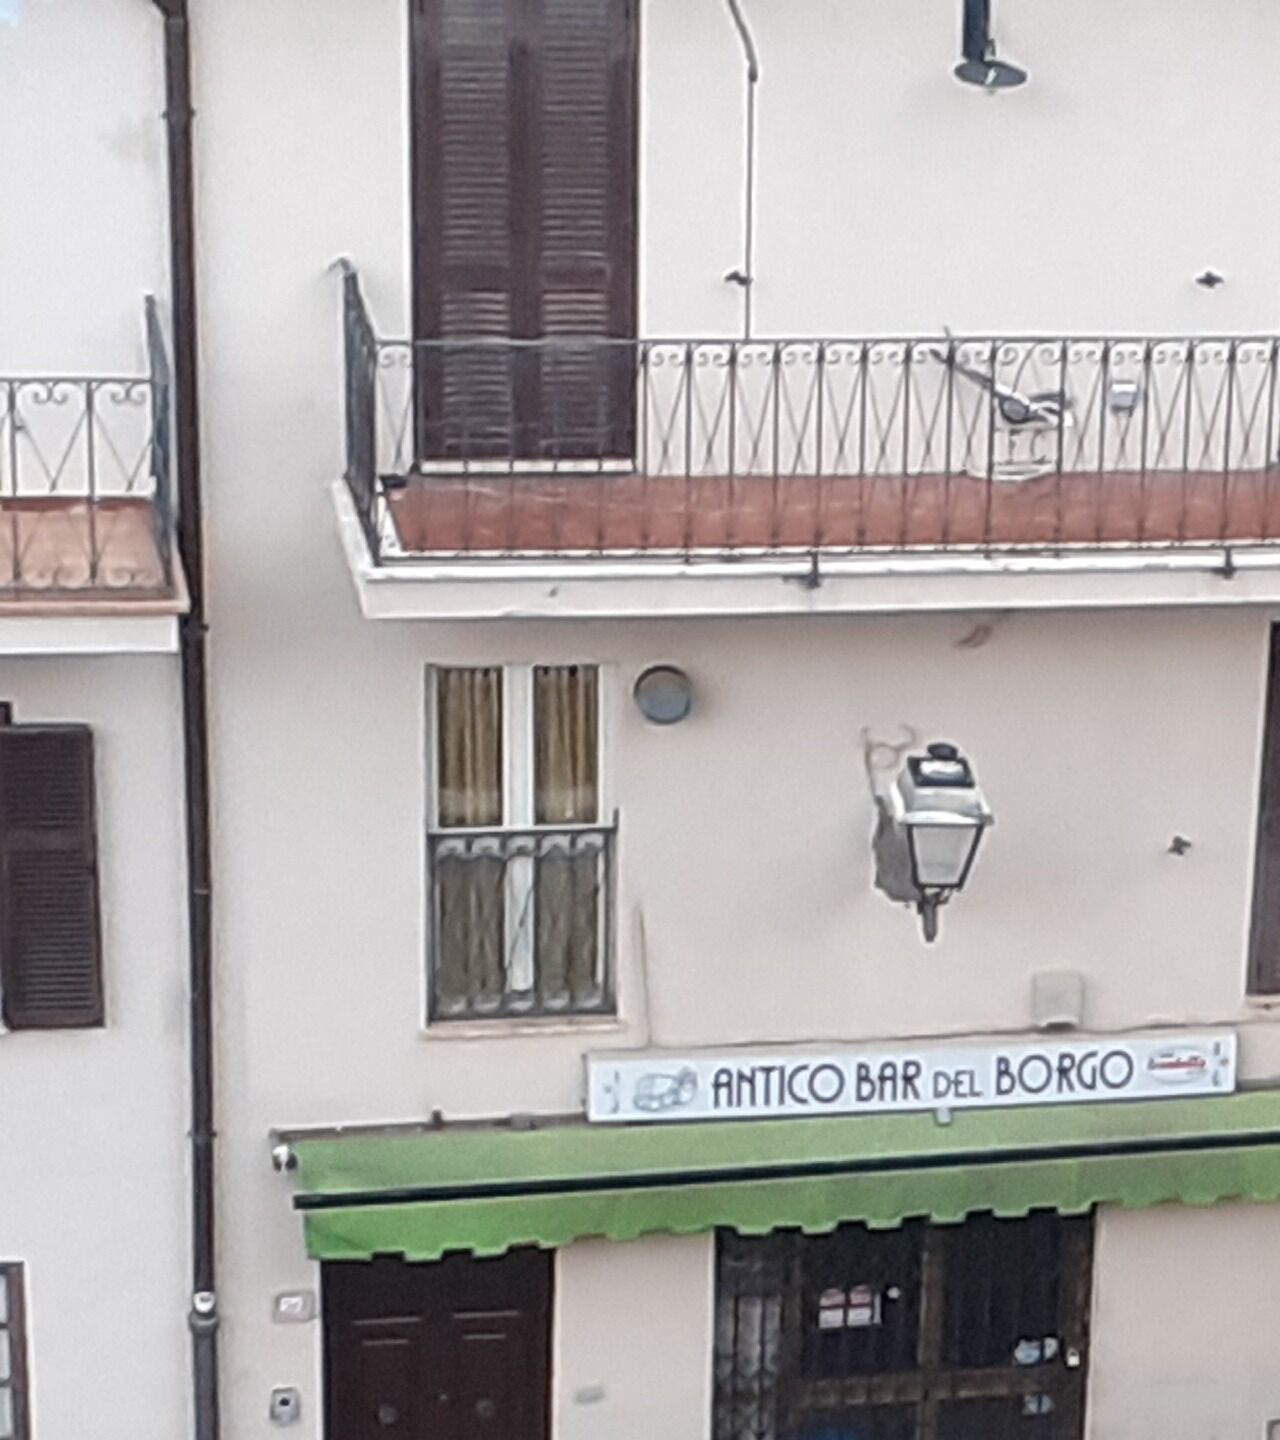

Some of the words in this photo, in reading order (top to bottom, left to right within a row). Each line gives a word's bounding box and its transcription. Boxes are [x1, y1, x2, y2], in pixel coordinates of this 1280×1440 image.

[711, 1064, 845, 1109] ANTICO
[854, 1061, 922, 1103] BAR
[932, 1071, 982, 1099] DEL
[995, 1049, 1134, 1095] BORGO
